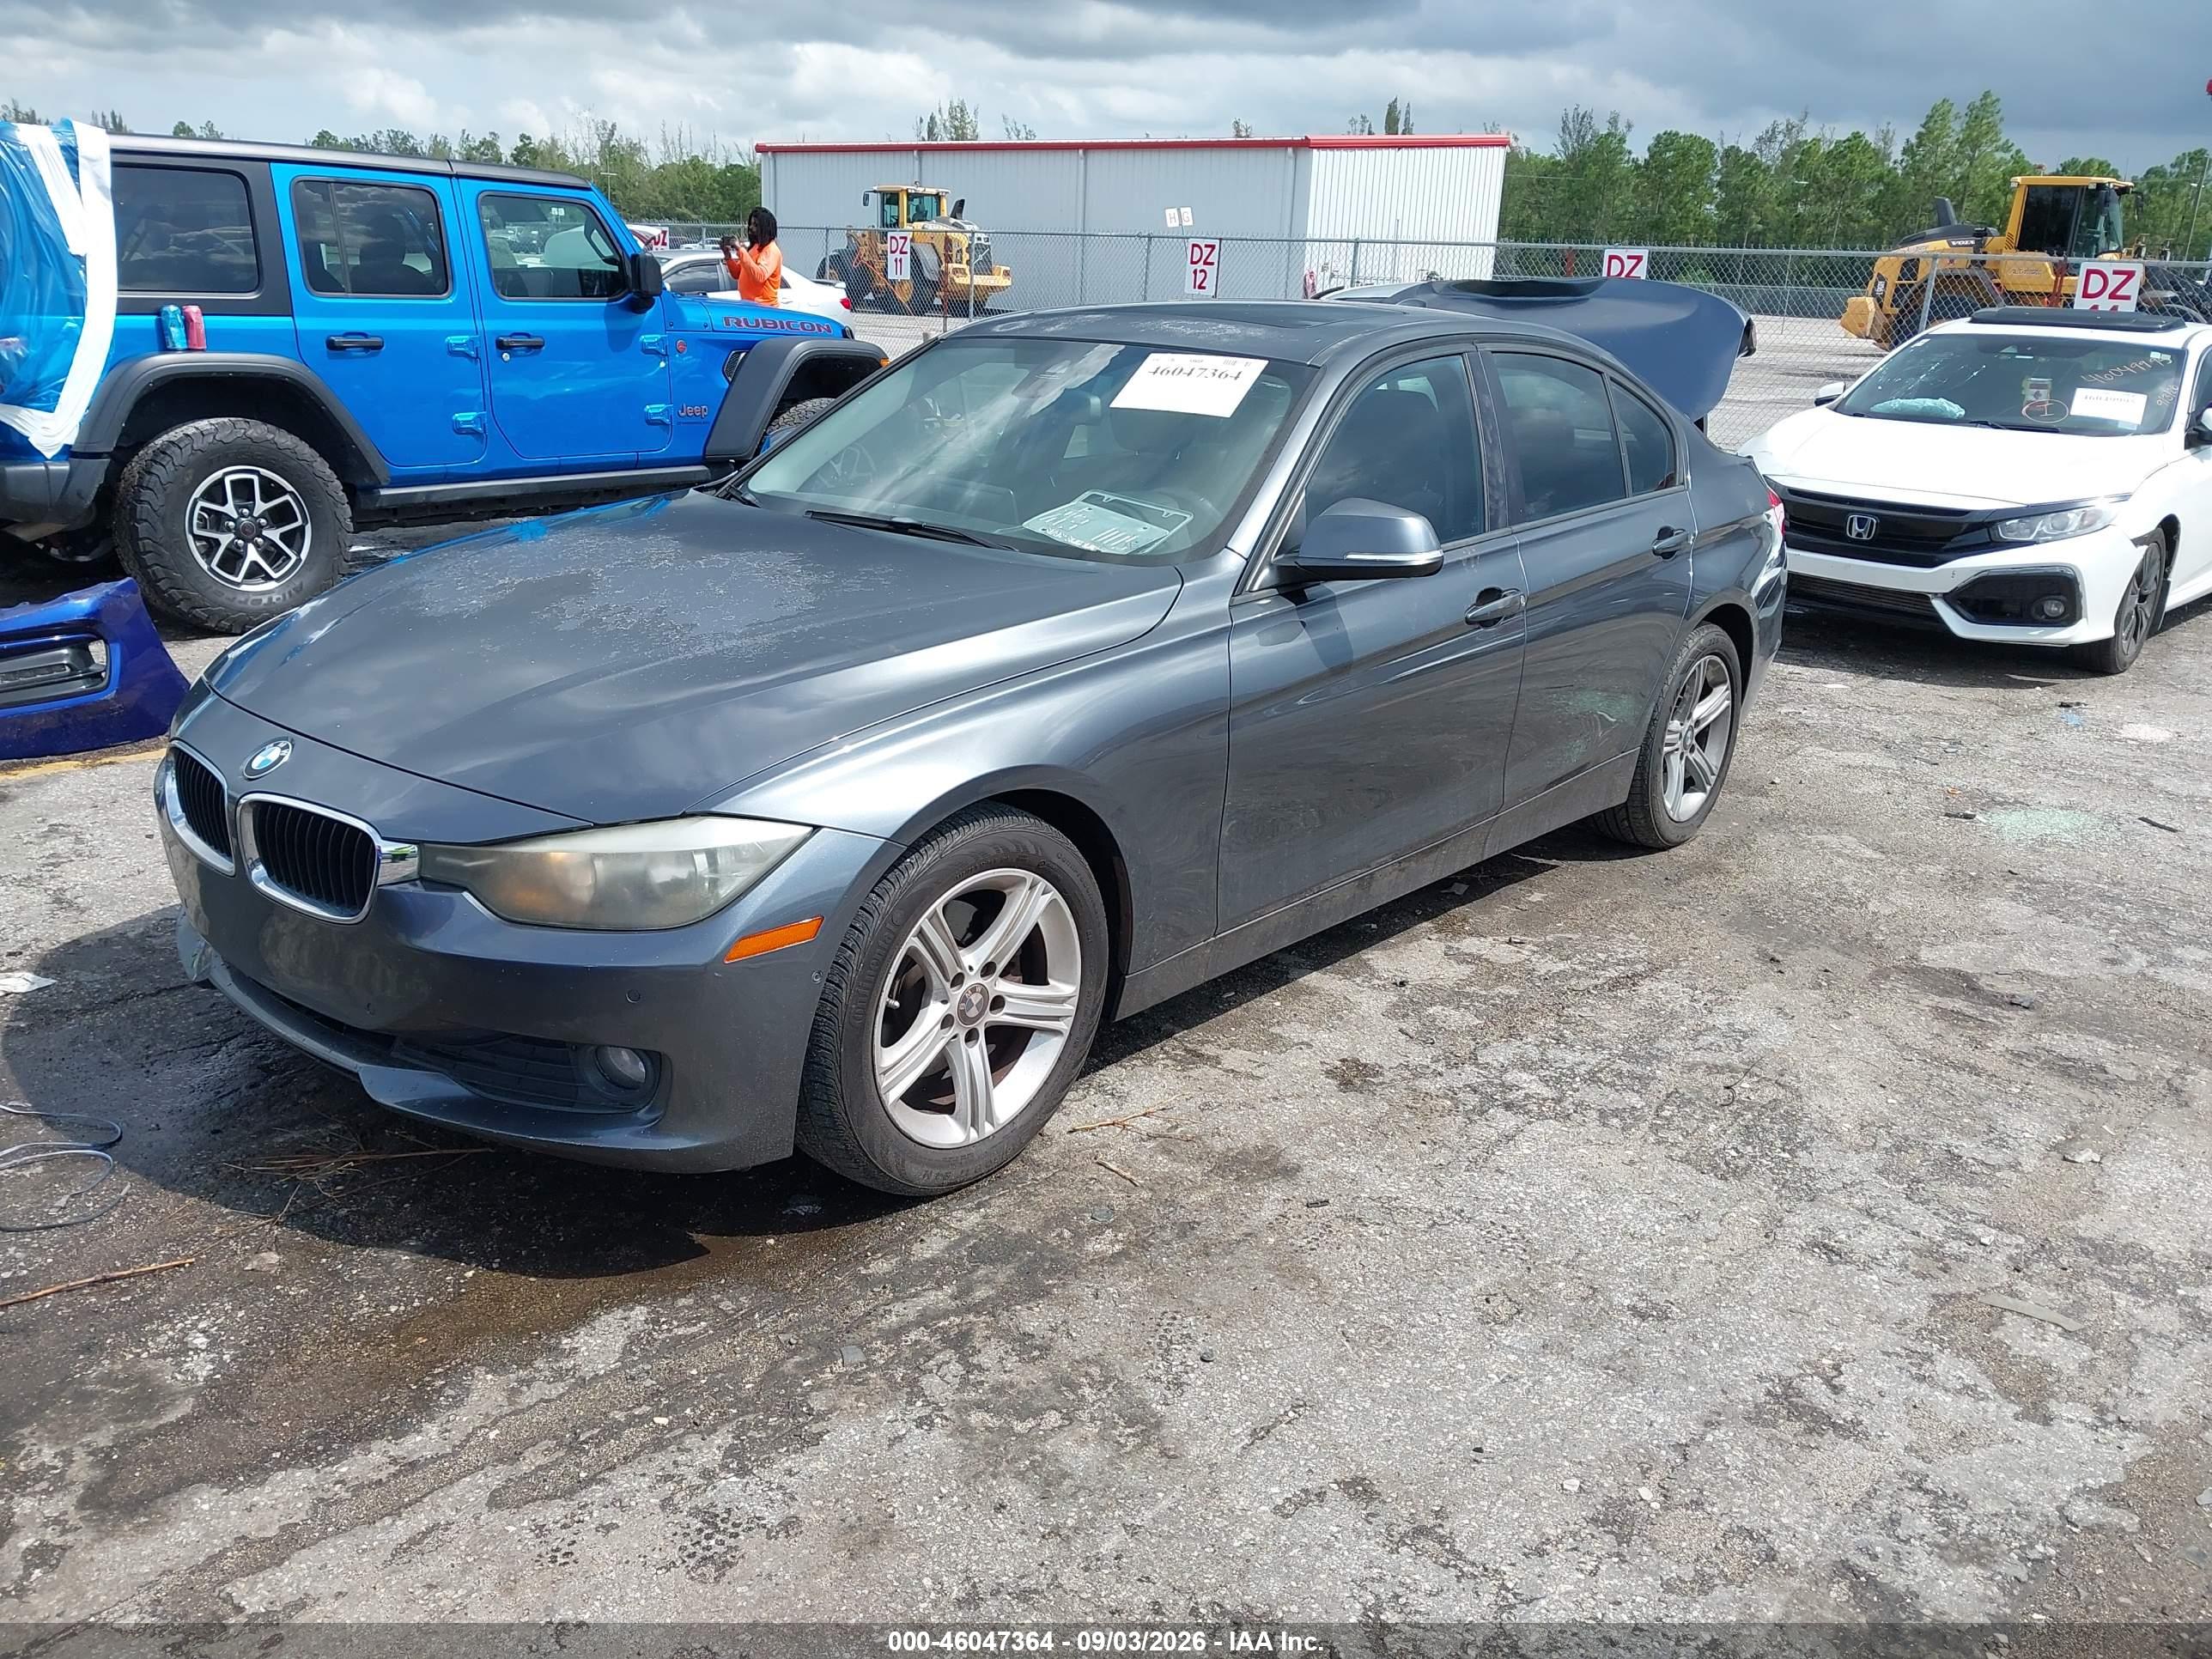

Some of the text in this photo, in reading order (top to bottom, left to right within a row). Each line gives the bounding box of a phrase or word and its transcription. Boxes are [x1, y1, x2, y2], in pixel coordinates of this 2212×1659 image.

[1169, 212, 1176, 224] H
[1182, 211, 1190, 223] G
[890, 236, 908, 254] DZ
[1190, 243, 1216, 266] DZ
[894, 258, 902, 276] 11
[1607, 254, 1644, 277] DZ
[1193, 268, 1207, 289] 12
[2081, 268, 2136, 301] DZ
[724, 316, 832, 334] RUBICON
[1148, 366, 1243, 380] 46047364
[678, 403, 708, 418] Jeep
